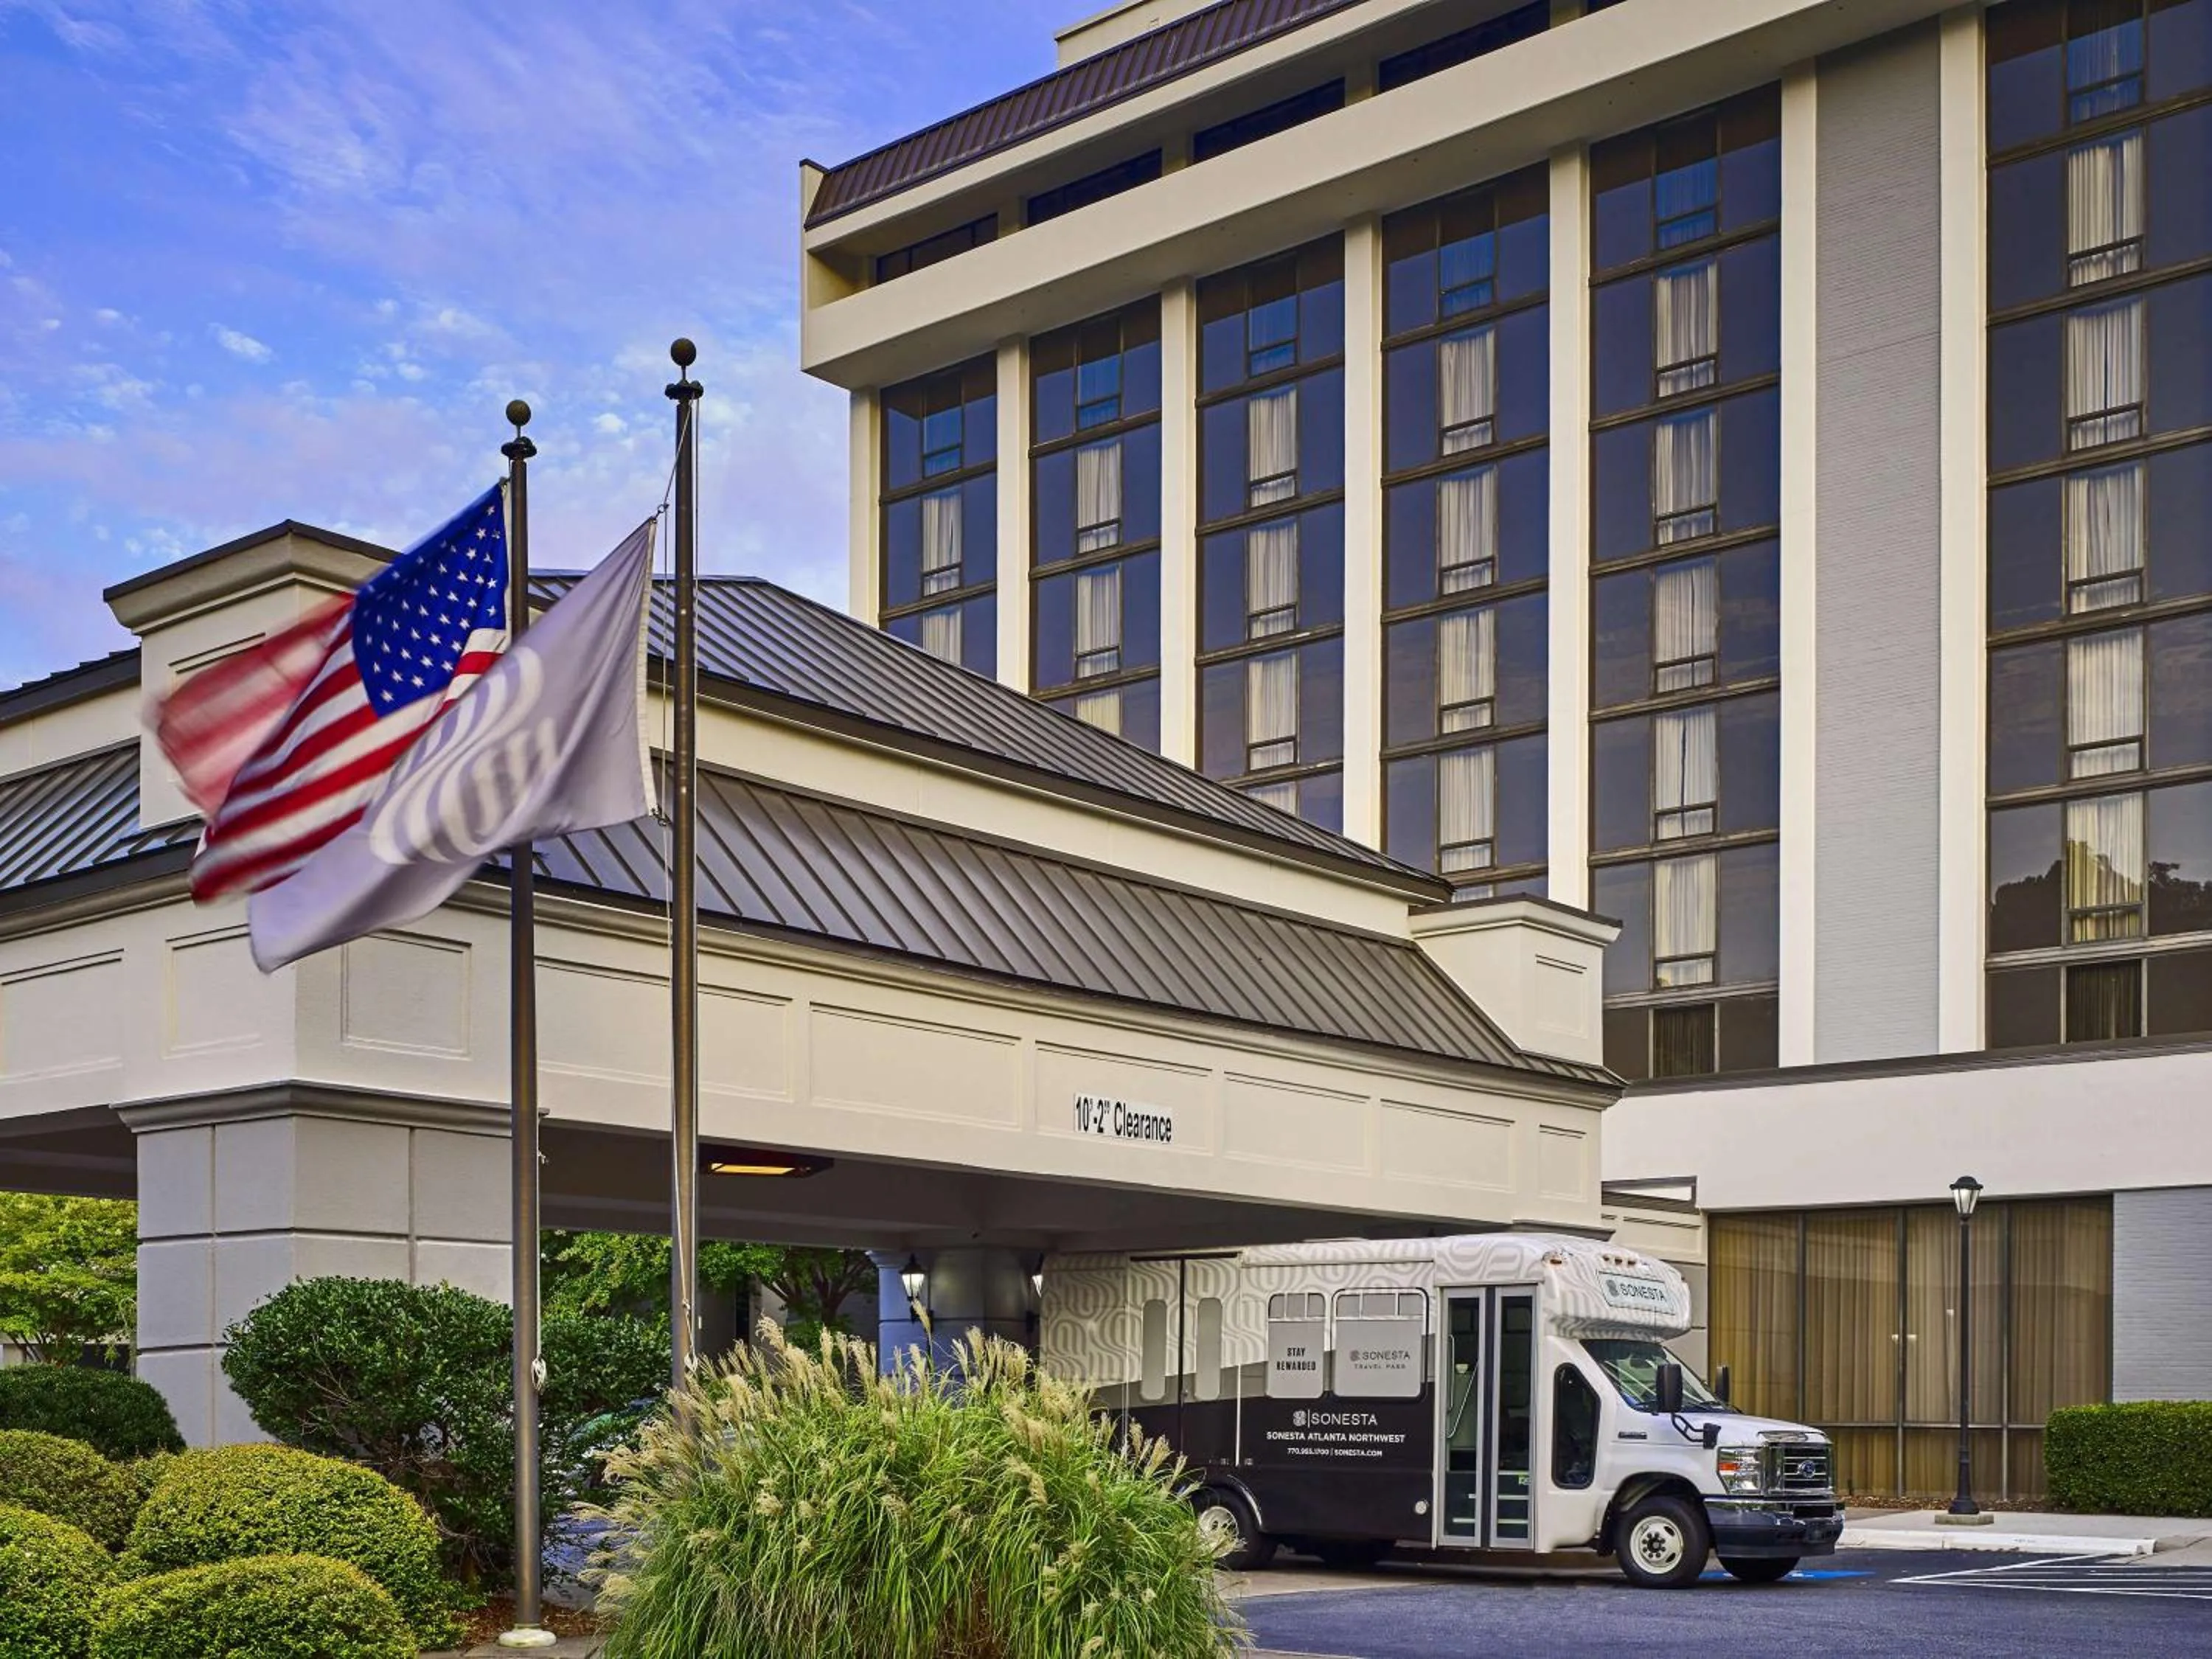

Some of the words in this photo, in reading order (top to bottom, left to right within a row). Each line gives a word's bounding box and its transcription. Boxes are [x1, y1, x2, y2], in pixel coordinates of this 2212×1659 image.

[1114, 1101, 1172, 1142] Clearance
[1619, 1283, 1667, 1302] SONESTA
[1287, 1347, 1306, 1357] STAY
[1362, 1349, 1410, 1360] SONESTA
[1311, 1412, 1378, 1425] SONESTA
[1266, 1431, 1305, 1440] SONESTA
[1307, 1433, 1346, 1441] ATLANTA
[1349, 1433, 1405, 1443] NORTHWEST
